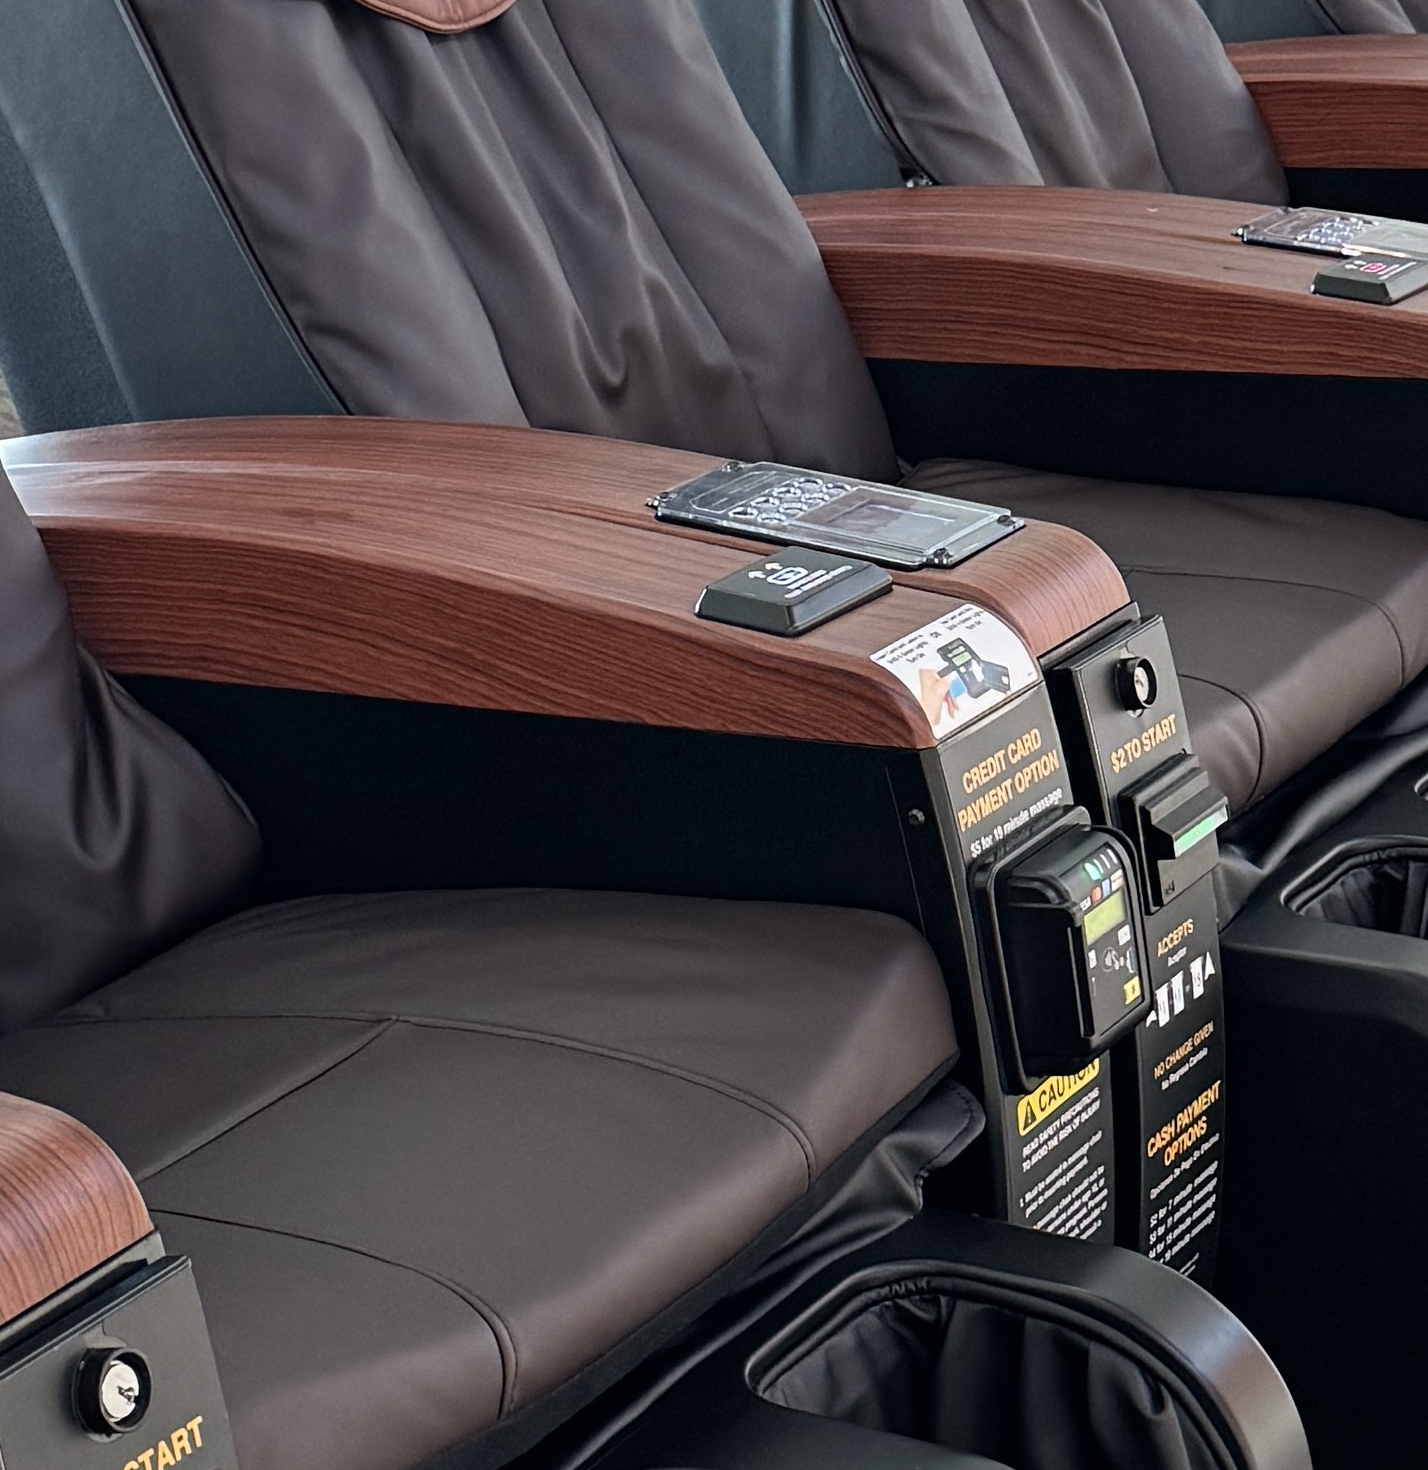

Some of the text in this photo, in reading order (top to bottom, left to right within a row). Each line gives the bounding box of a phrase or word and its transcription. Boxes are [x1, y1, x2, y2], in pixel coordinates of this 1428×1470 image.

[962, 728, 1042, 794] CREDIT CARD
[1111, 713, 1176, 774] $2 TO START
[957, 749, 1060, 832] PAYMENT OPTION
[1147, 1079, 1221, 1158] CASH PAYMENT
[1164, 1115, 1207, 1166] OPTIONS
